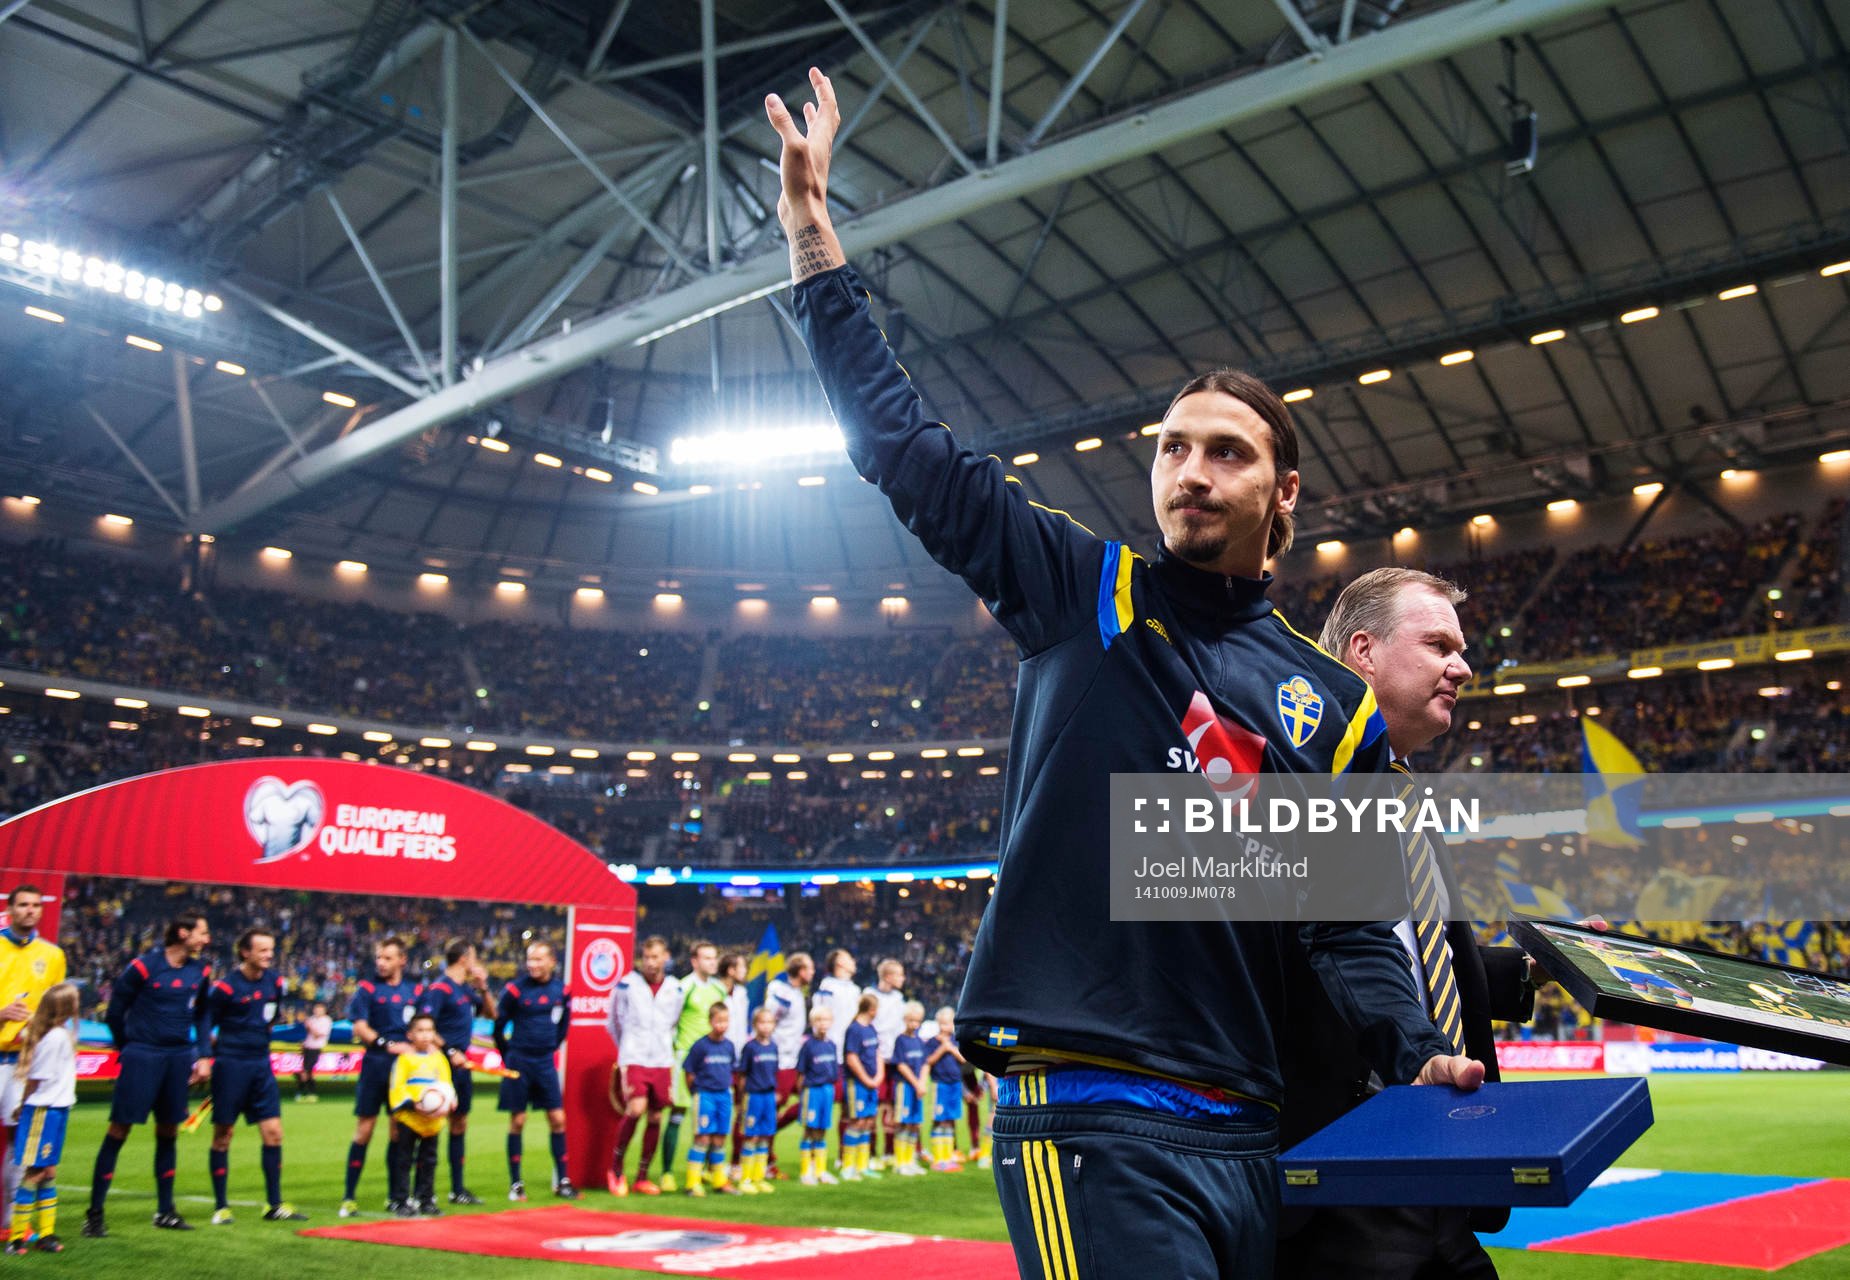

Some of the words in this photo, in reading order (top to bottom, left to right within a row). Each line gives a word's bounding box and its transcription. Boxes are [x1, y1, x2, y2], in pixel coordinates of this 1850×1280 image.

[1145, 618, 1172, 646] adid
[336, 804, 446, 835] EUROPEAN
[320, 826, 457, 862] QUALIFIERS
[1235, 831, 1283, 874] PEL
